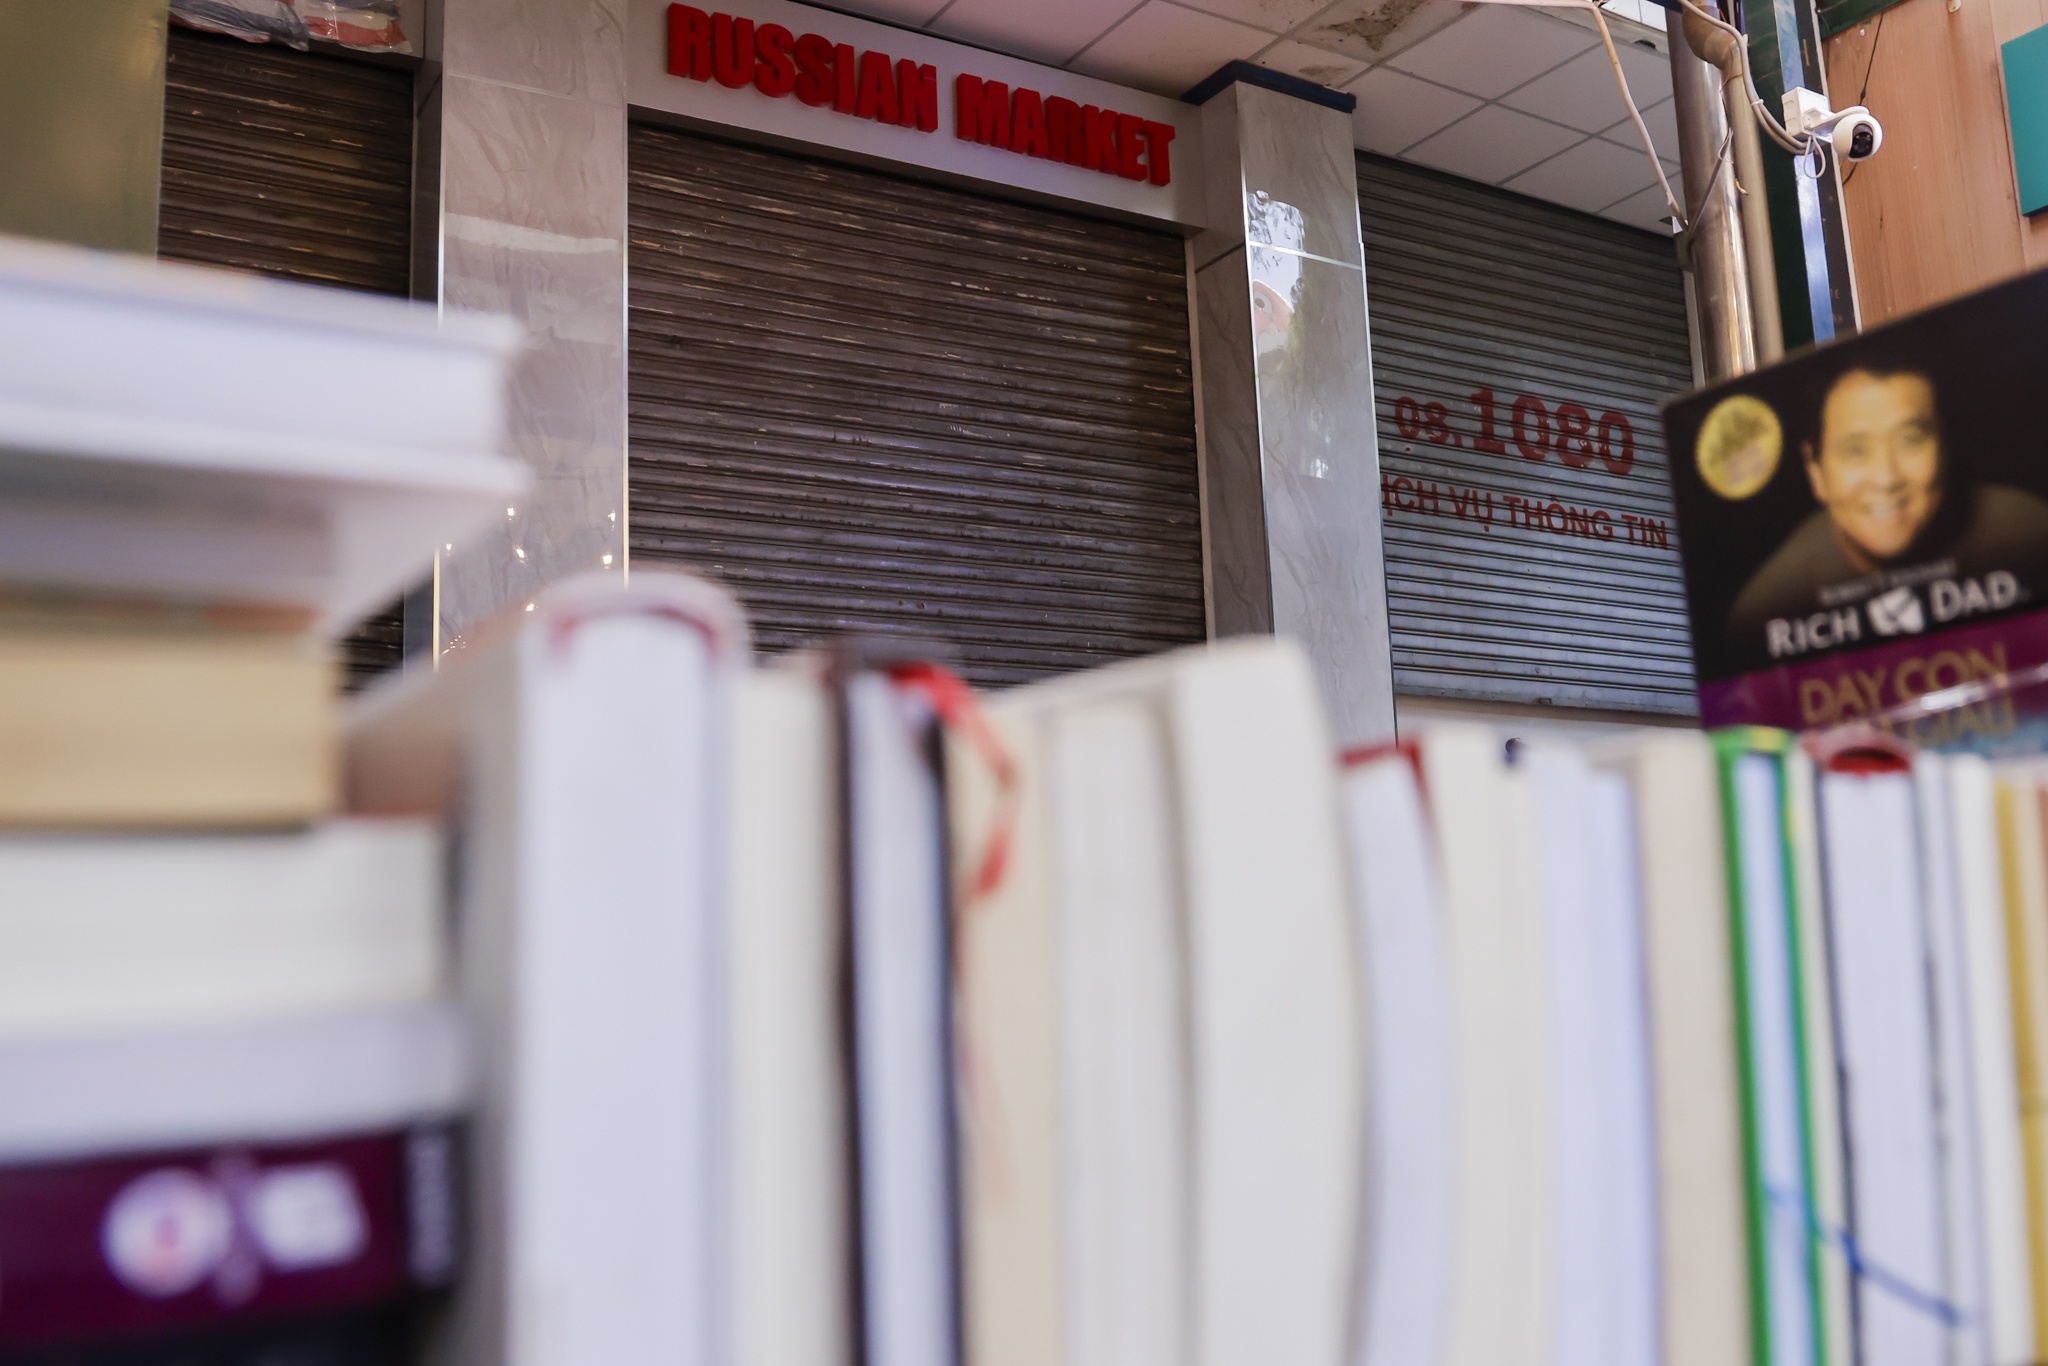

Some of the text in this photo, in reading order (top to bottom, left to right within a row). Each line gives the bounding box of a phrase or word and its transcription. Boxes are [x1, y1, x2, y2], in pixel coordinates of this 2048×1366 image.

[667, 2, 1177, 187] RUSSIAN MARKET
[1381, 474, 1668, 550] ỊCH VỤ THÔNG TIN
[1766, 606, 1861, 658] RICH
[1894, 642, 2010, 704] CON
